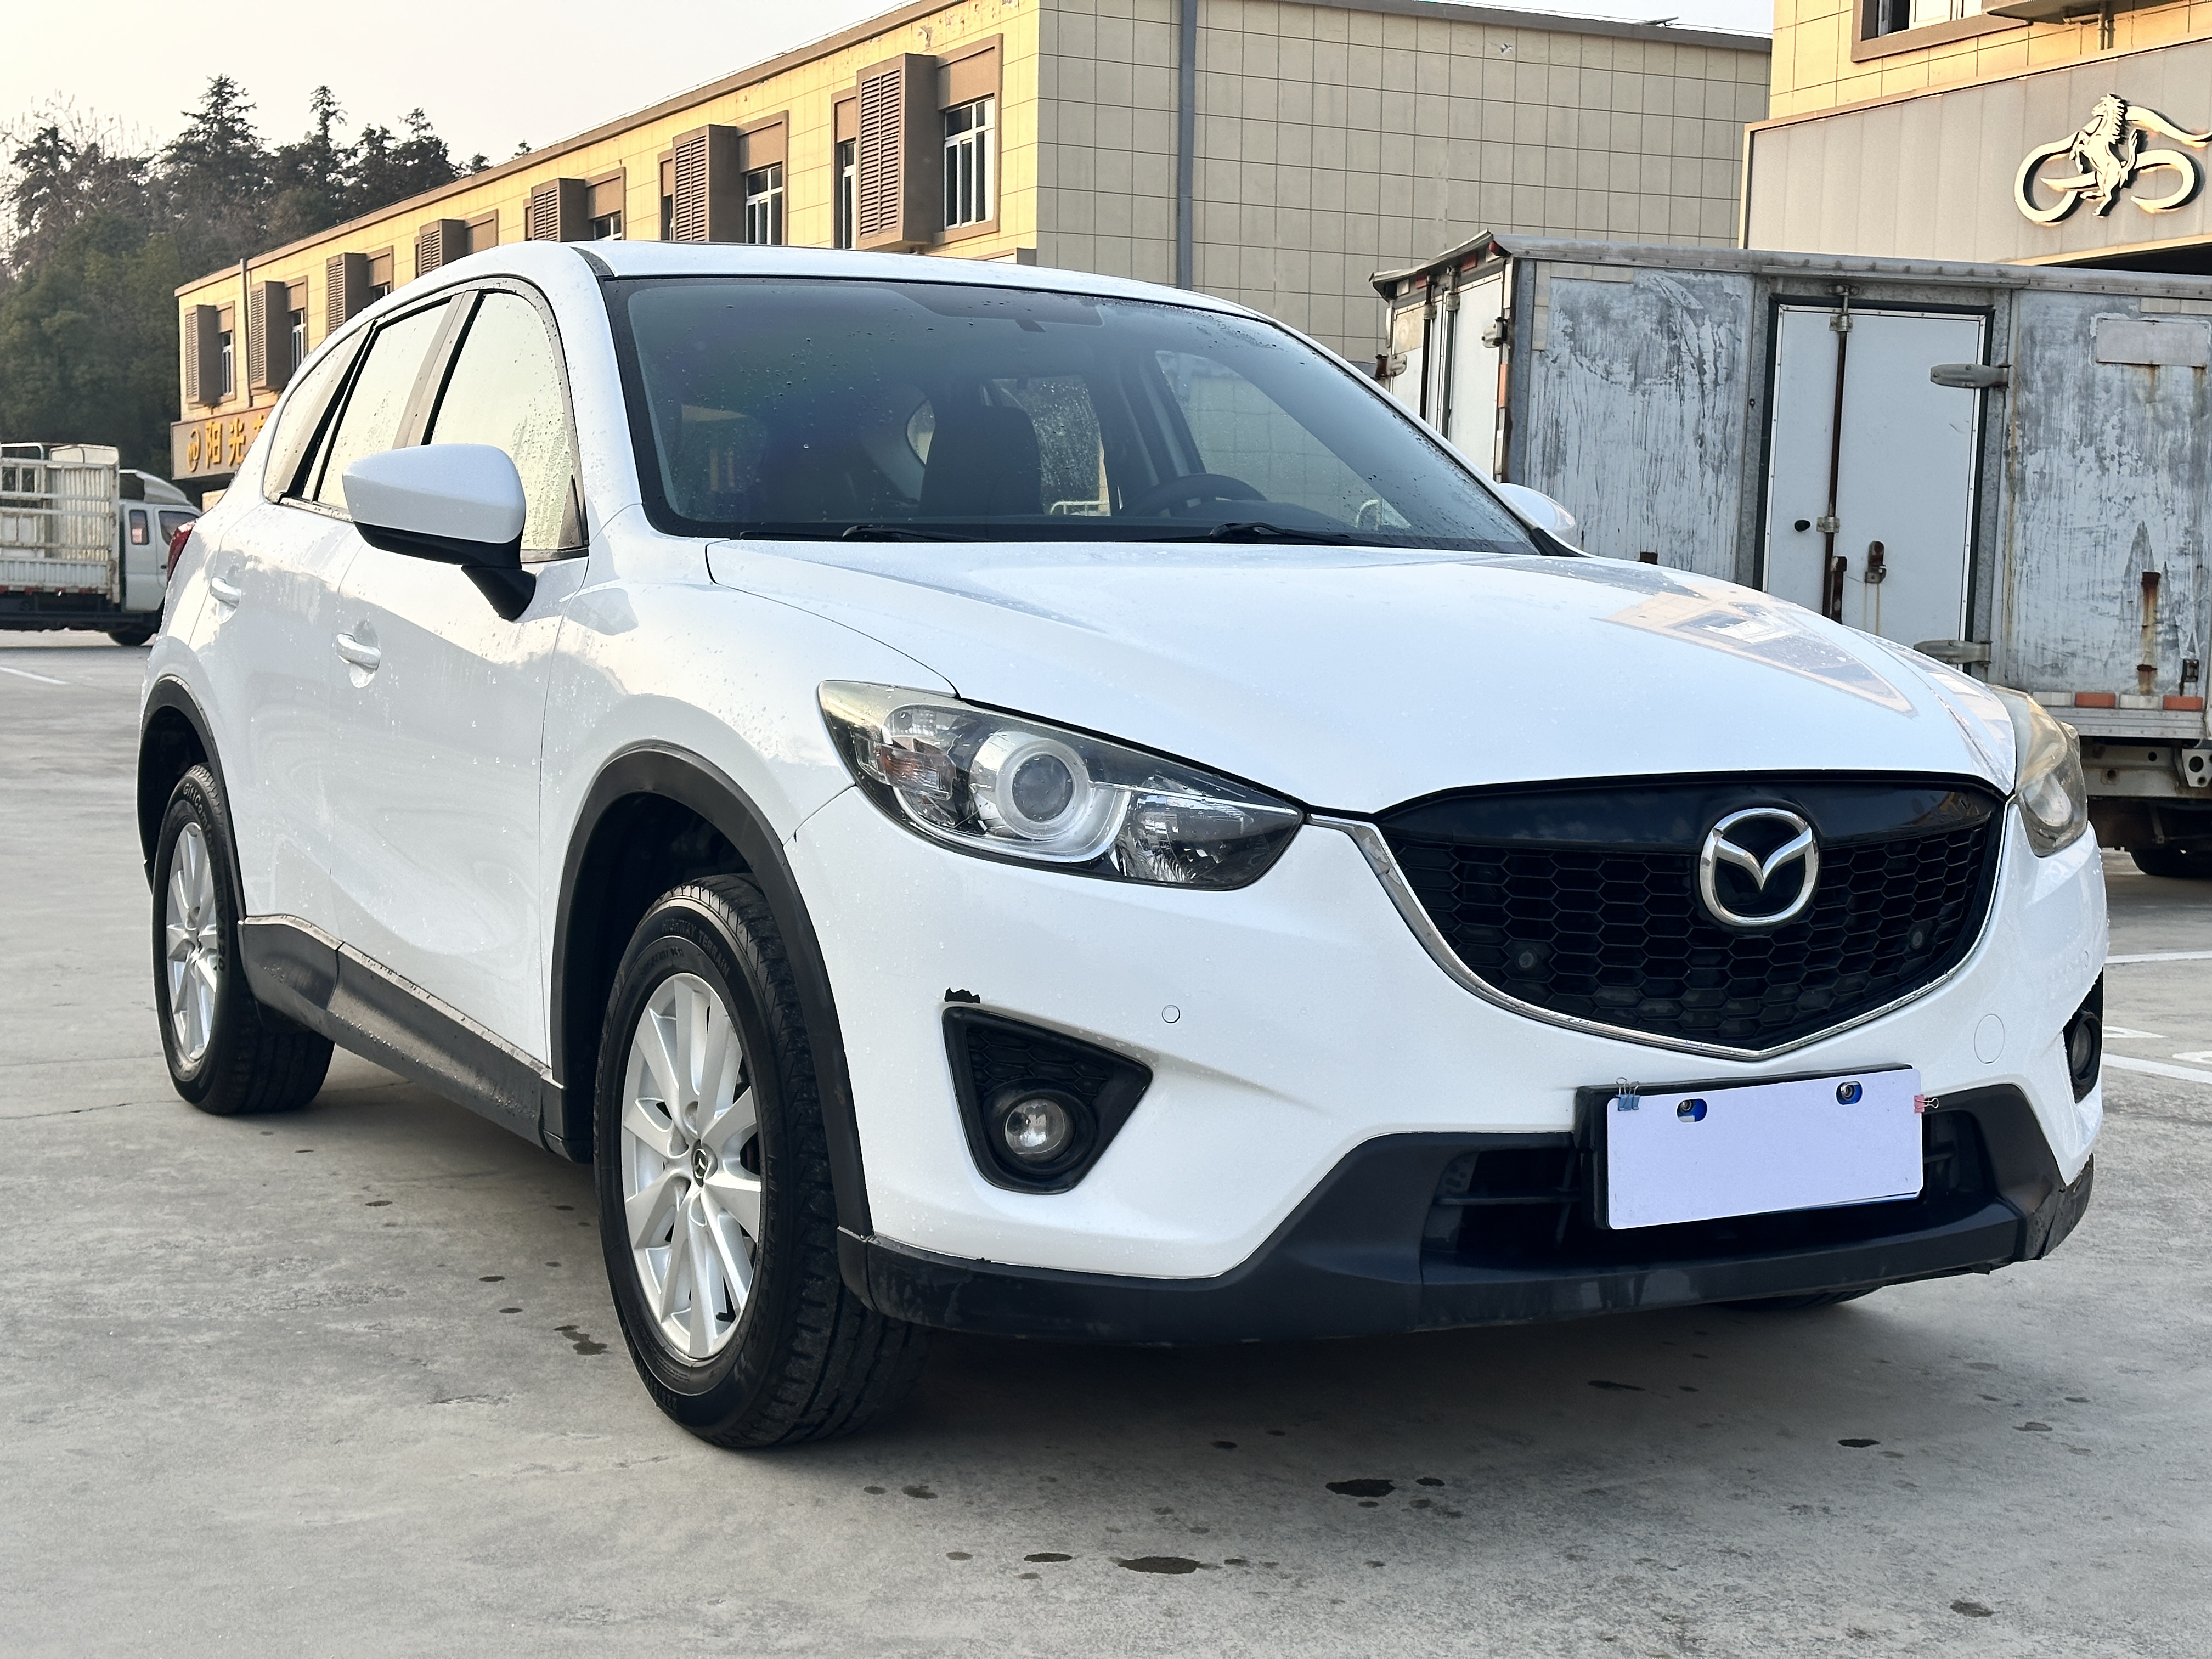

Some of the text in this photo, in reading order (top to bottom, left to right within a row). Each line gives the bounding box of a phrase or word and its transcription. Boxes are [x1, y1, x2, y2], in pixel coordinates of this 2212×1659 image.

[183, 782, 219, 864] GitiComfor
[215, 871, 226, 972] UV520
[698, 929, 731, 977] TERRAIN
